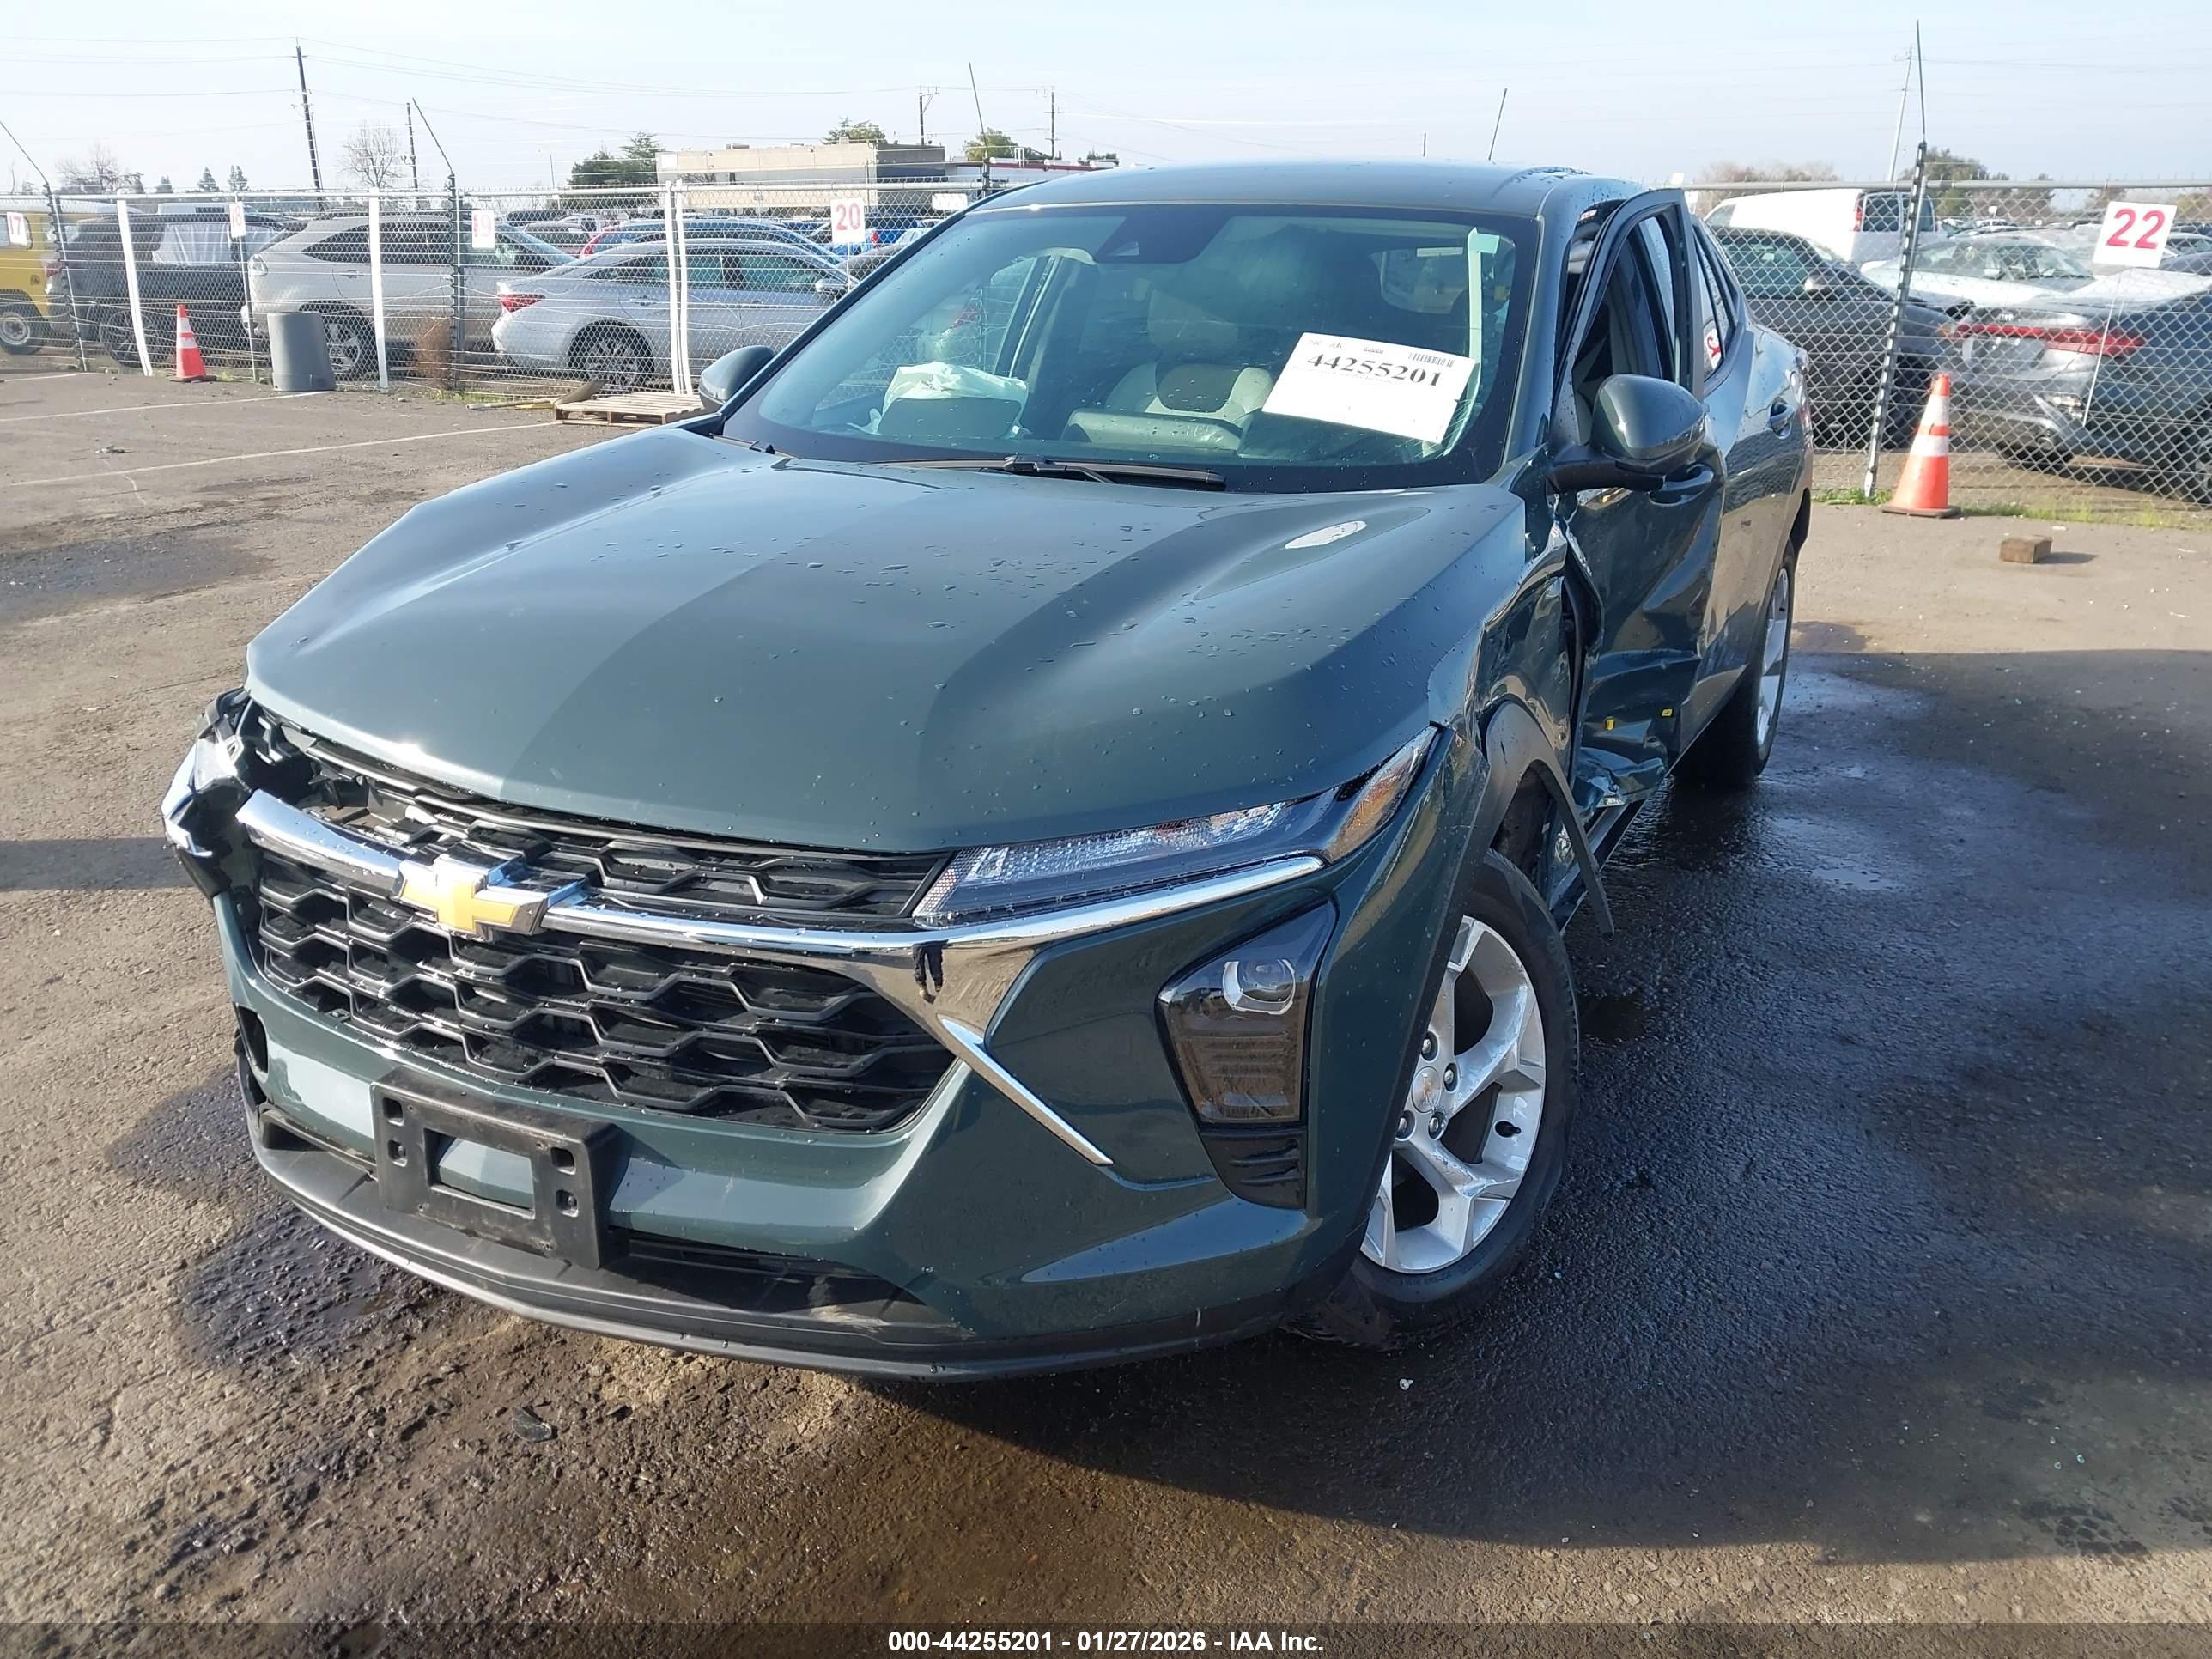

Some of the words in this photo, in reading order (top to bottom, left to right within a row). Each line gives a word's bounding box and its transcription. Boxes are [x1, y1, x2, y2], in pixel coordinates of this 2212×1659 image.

[9, 215, 21, 235] 17
[835, 202, 860, 231] 20
[2105, 208, 2166, 249] 22
[1307, 353, 1441, 386] 44255201
